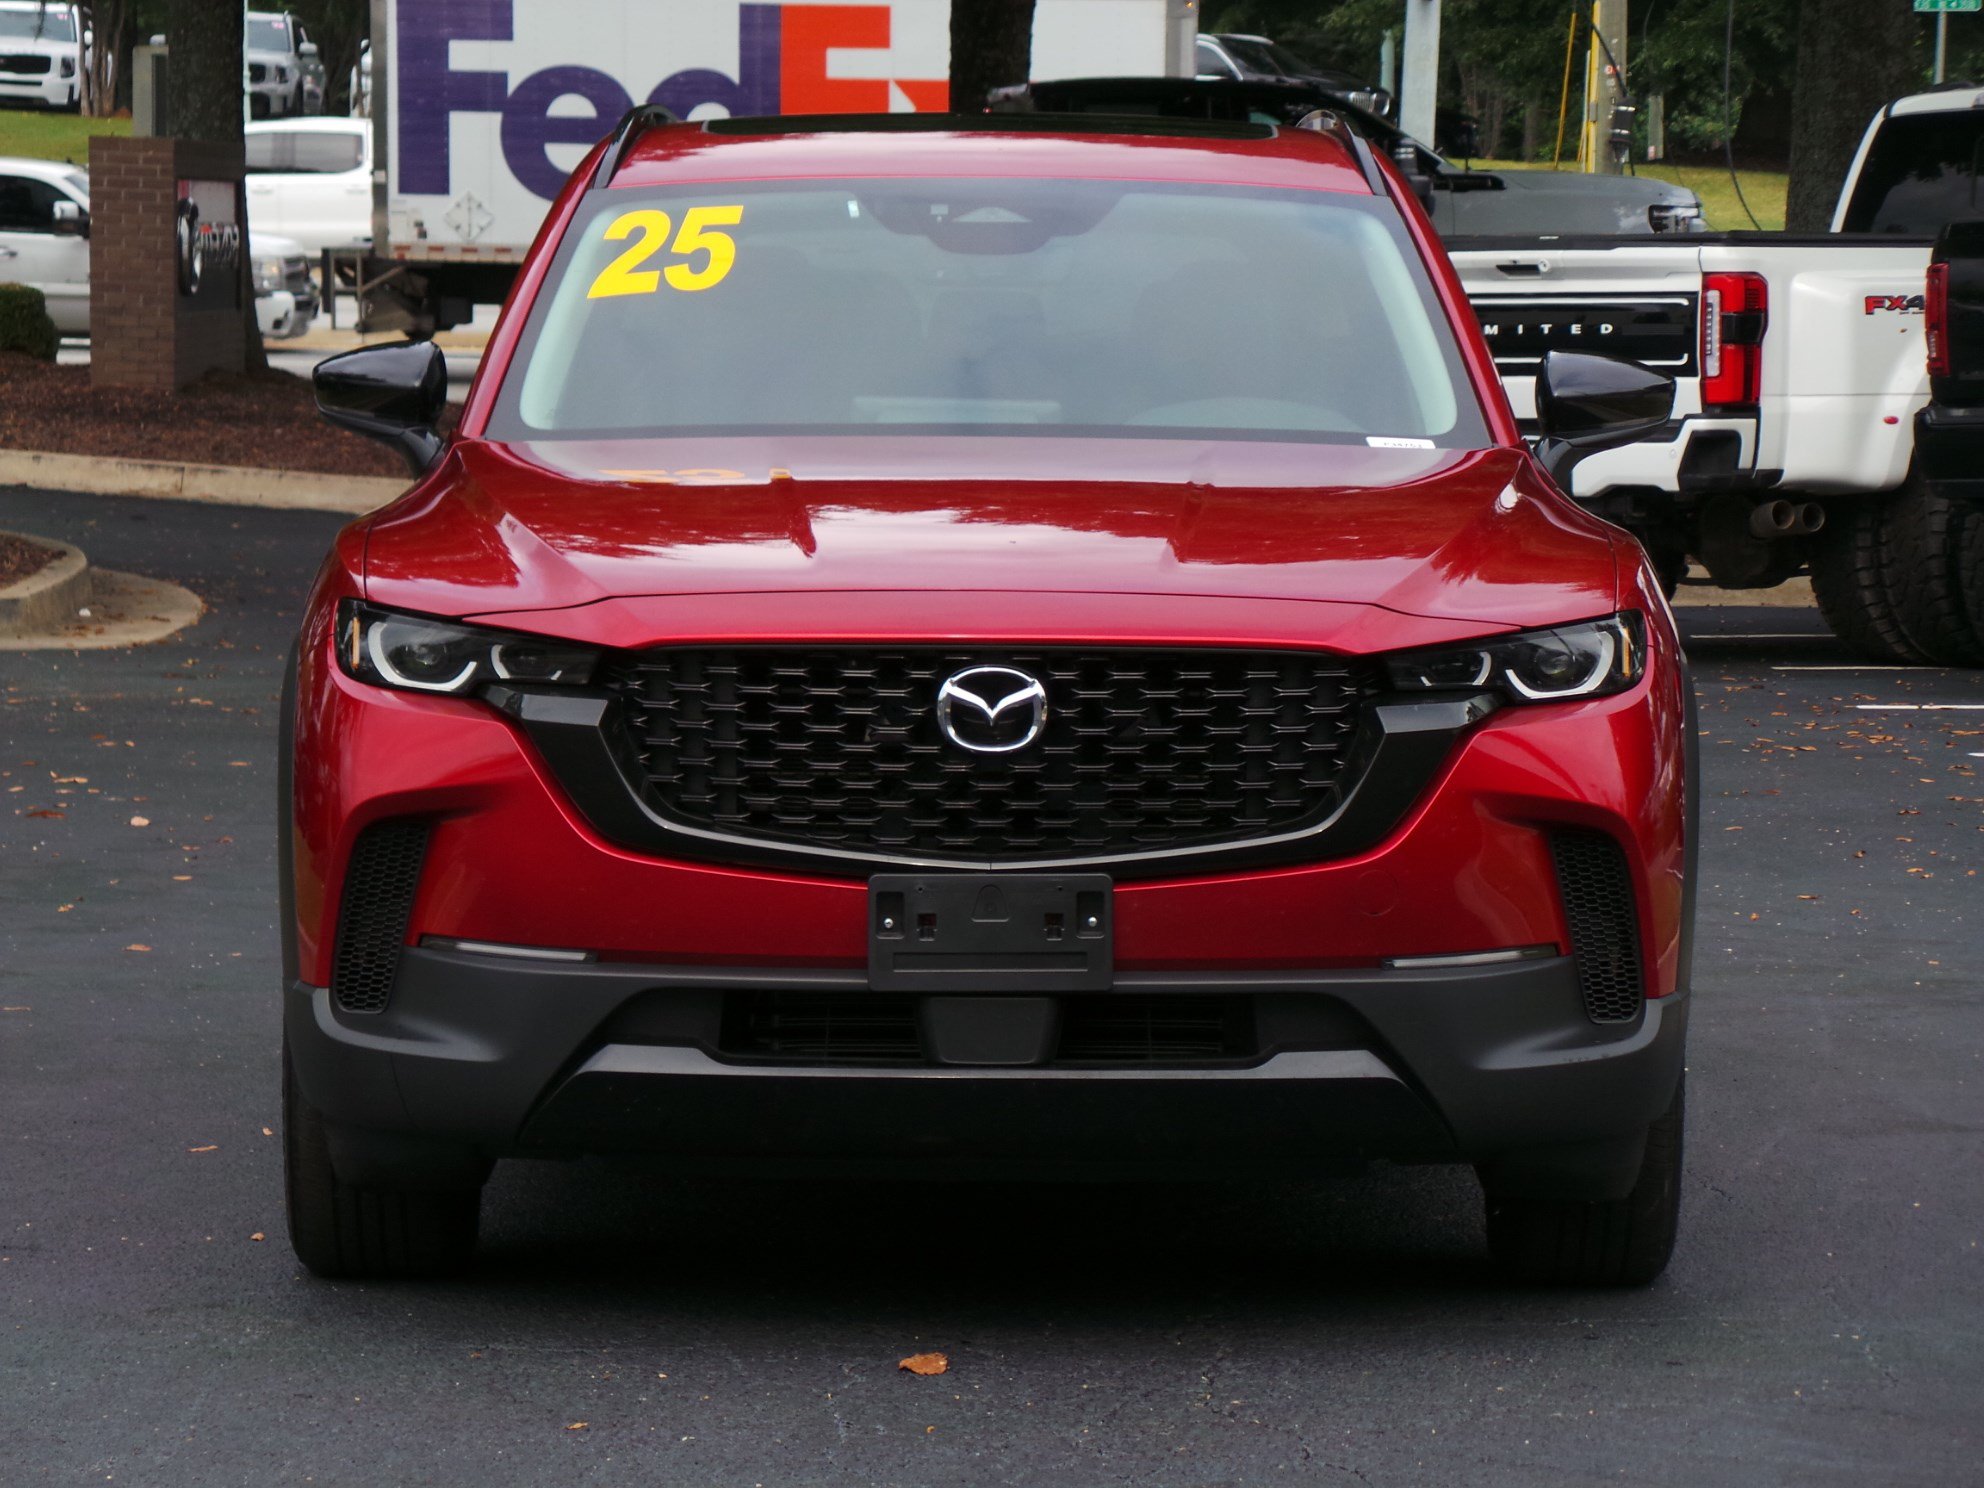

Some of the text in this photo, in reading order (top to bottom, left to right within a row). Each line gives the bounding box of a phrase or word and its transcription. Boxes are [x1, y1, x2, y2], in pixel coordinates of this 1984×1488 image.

[587, 205, 744, 299] 25
[1865, 295, 1924, 315] FX4
[1484, 324, 1614, 335] MITED
